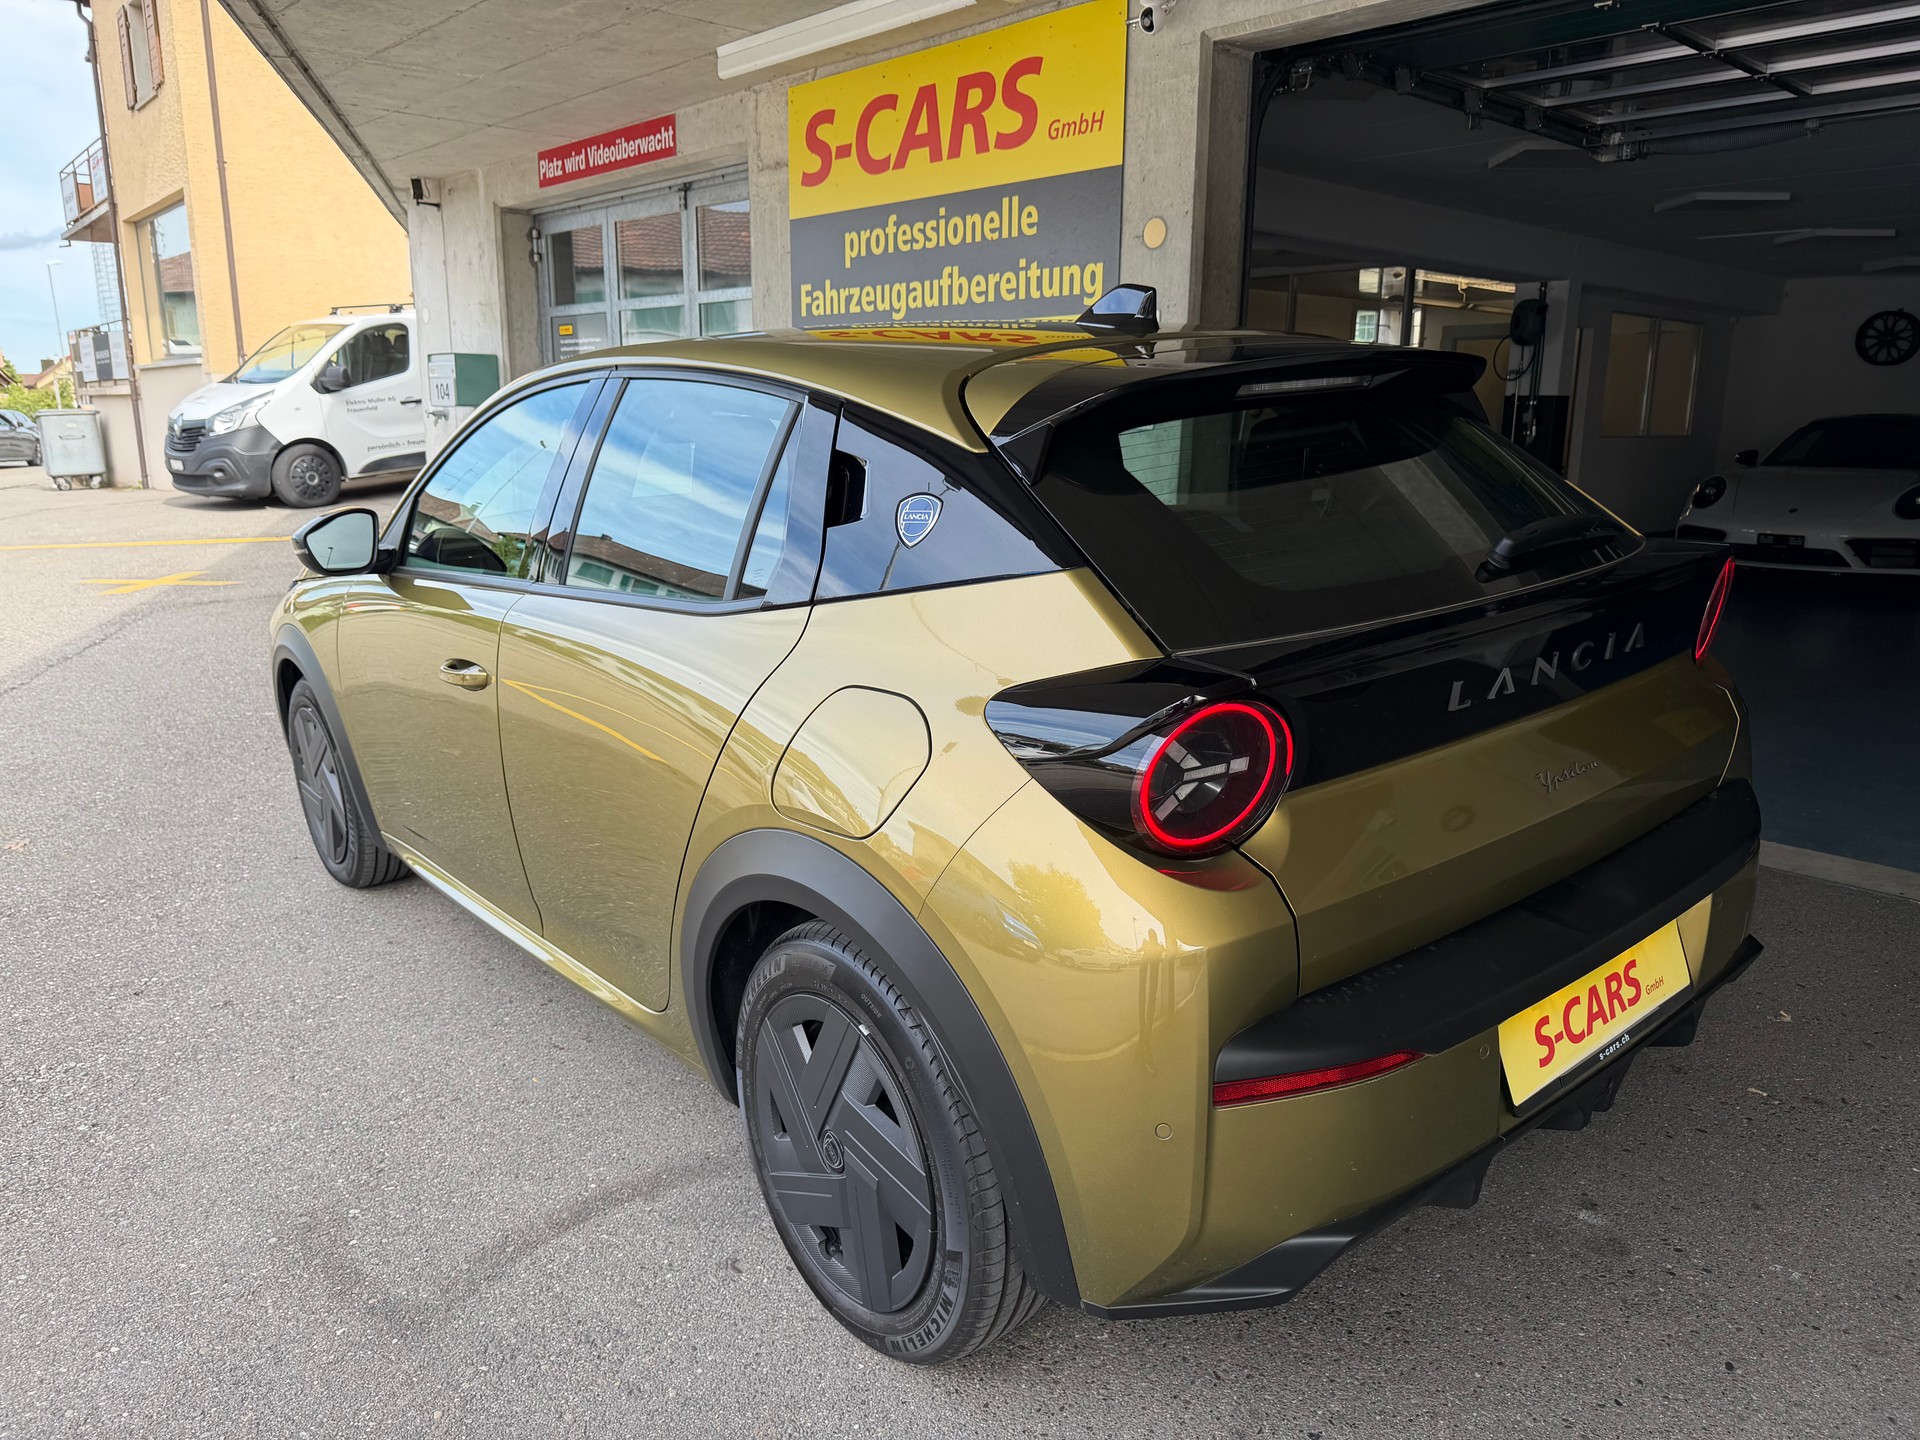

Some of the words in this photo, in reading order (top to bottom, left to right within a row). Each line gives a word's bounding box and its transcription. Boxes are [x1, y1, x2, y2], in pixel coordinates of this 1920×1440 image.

[539, 159, 563, 180] Platz
[564, 148, 586, 174] wird
[587, 125, 674, 168] Videoüberwacht
[800, 56, 1044, 188] S-CARS
[1048, 110, 1104, 141] GmbH
[843, 195, 1039, 269] professionelle
[800, 258, 1104, 321] Fahrzeugaufbereitung
[435, 383, 450, 400] 104
[1447, 622, 1645, 712] LANCIA
[1535, 761, 1598, 794] Ypsilon
[860, 993, 882, 1019] OUTSIDE
[1534, 959, 1642, 1068] S-CARS
[1645, 975, 1665, 995] GmbH
[1599, 1033, 1630, 1060] s-cars.ch
[889, 1291, 954, 1353] MICHELIN
